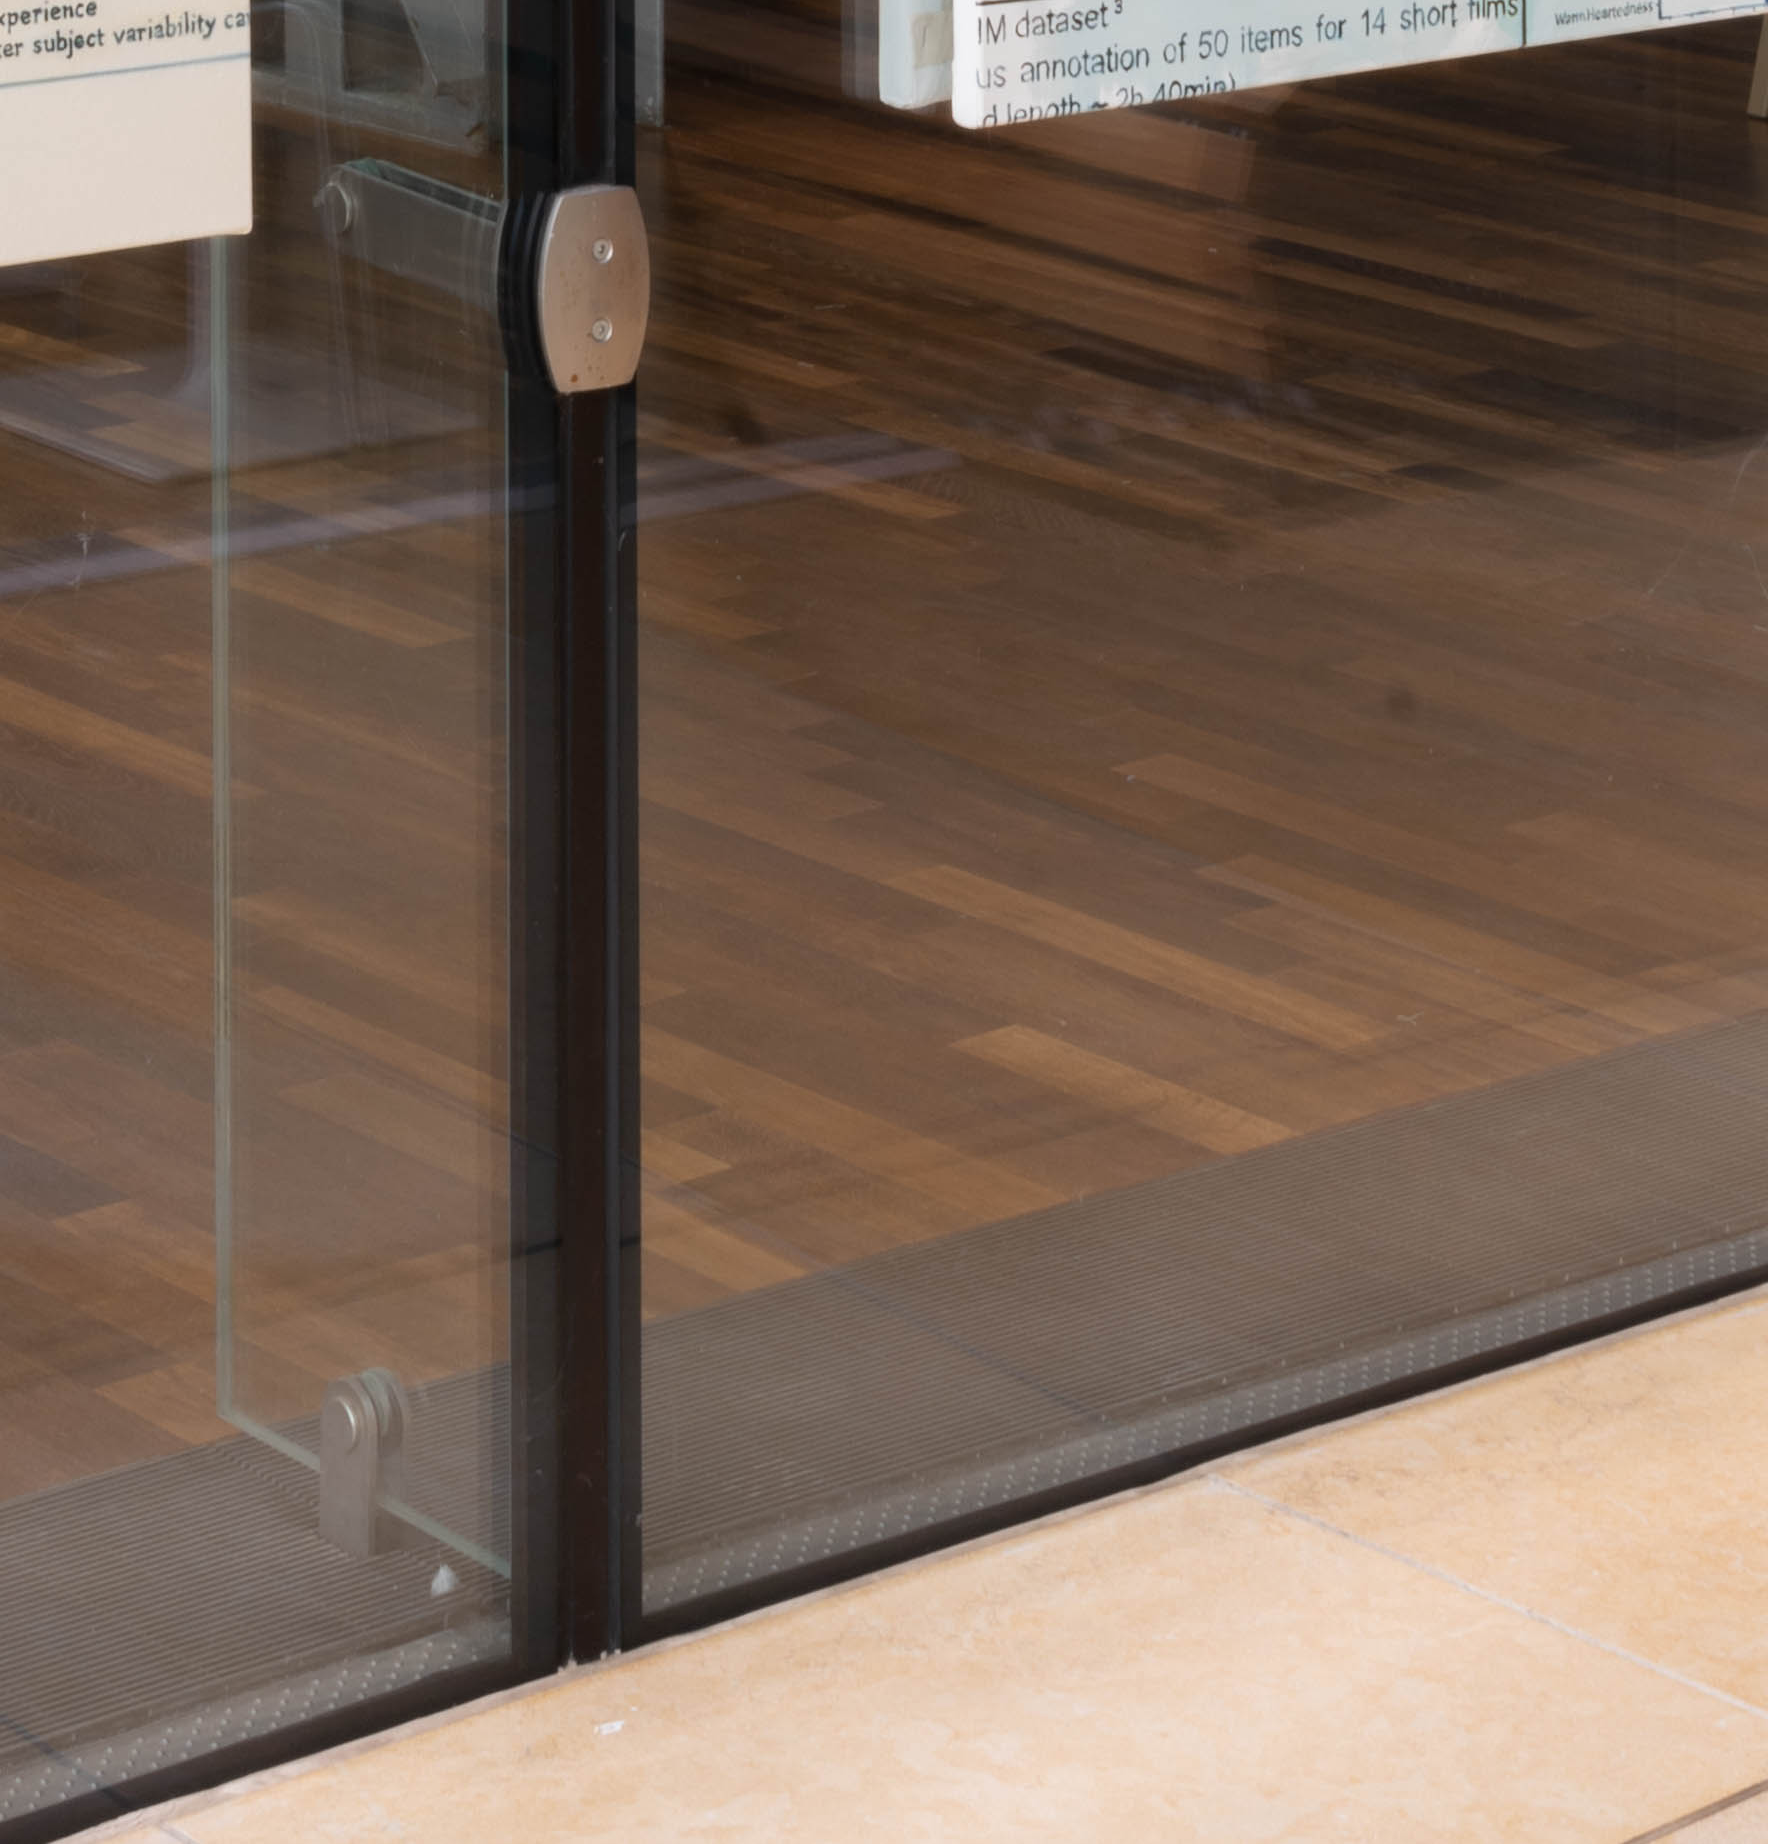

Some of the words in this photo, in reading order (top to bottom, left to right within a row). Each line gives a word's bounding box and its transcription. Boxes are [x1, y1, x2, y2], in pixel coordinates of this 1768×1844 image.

[1020, 44, 1150, 83] annotation
[1162, 32, 1188, 64] of
[1198, 29, 1229, 60] 50
[1241, 25, 1303, 53] items
[1316, 14, 1347, 42] for
[1361, 7, 1386, 37] 14
[1400, 0, 1458, 32] short
